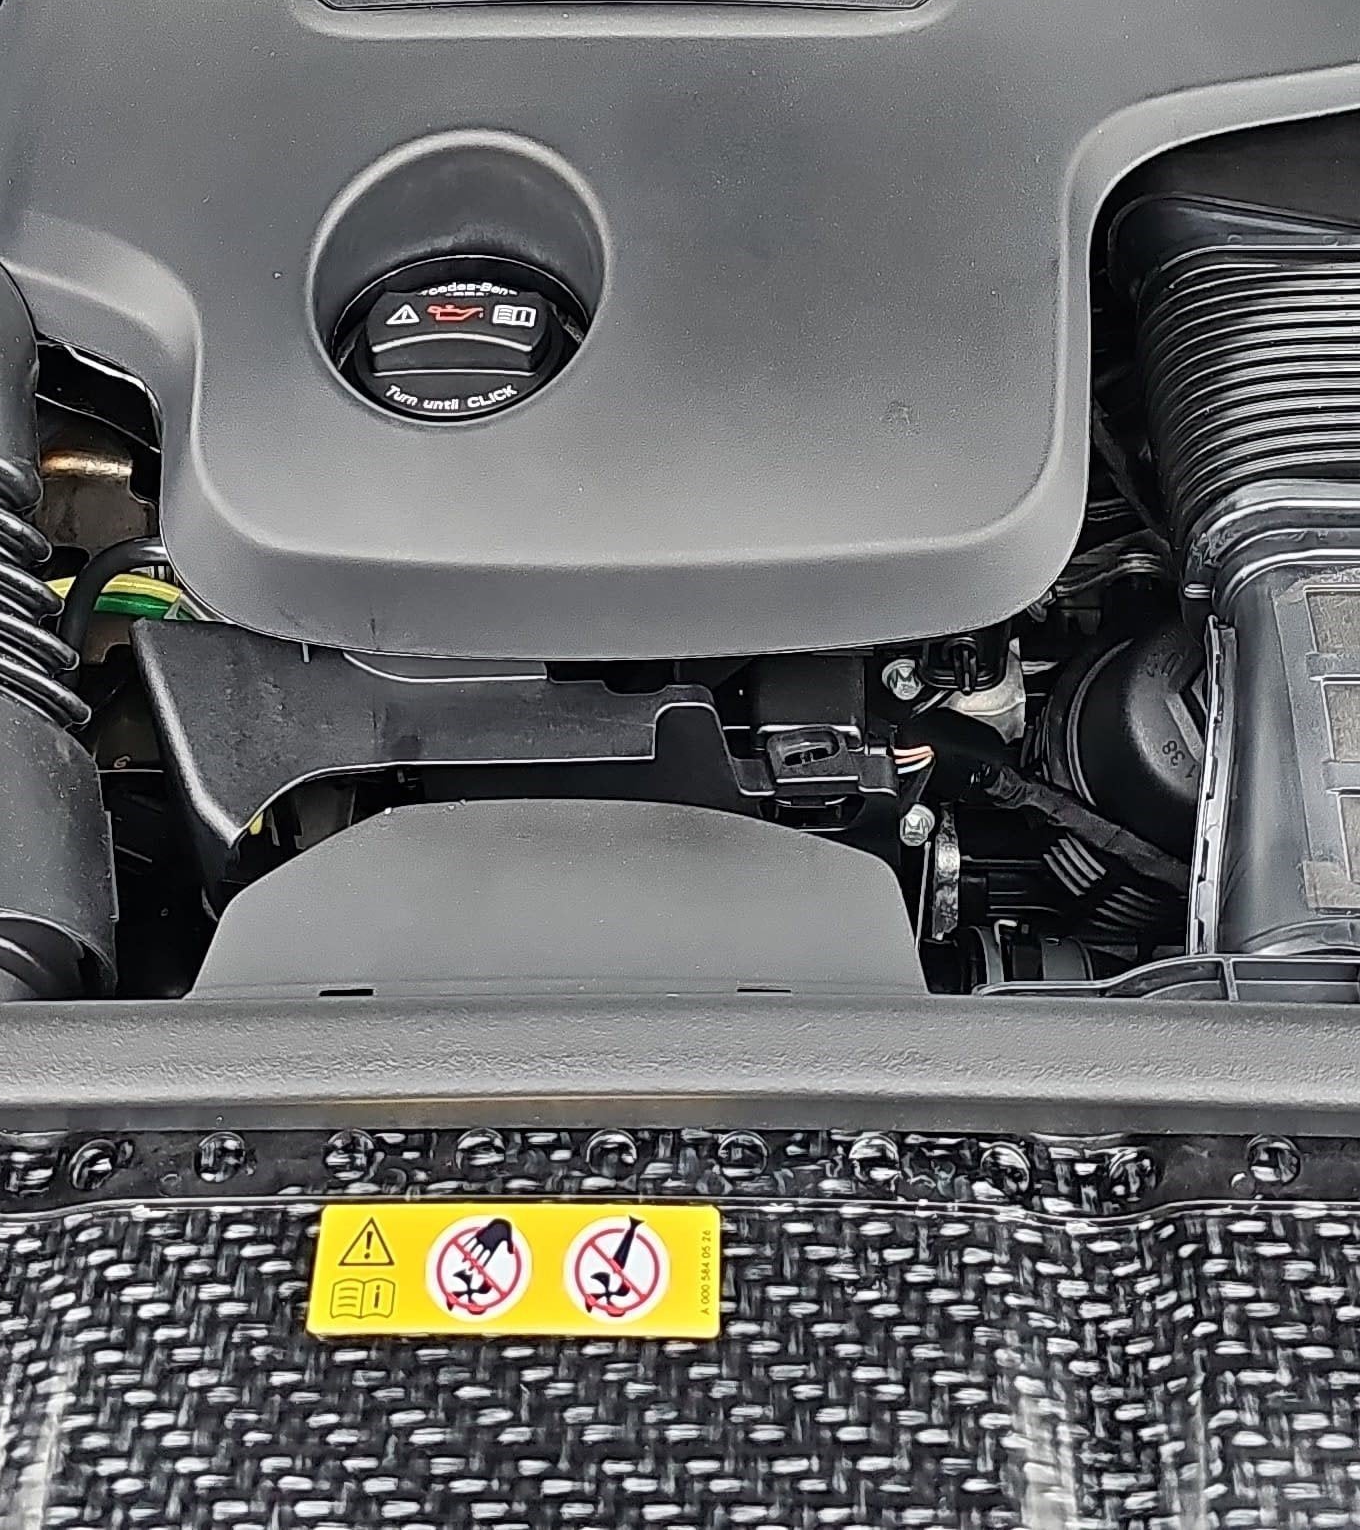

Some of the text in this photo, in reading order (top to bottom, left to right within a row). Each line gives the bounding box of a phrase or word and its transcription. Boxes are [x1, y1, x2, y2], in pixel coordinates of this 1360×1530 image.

[386, 384, 518, 411] Turn until CLICK
[700, 1261, 711, 1282] 584
[700, 1284, 710, 1305] 000
